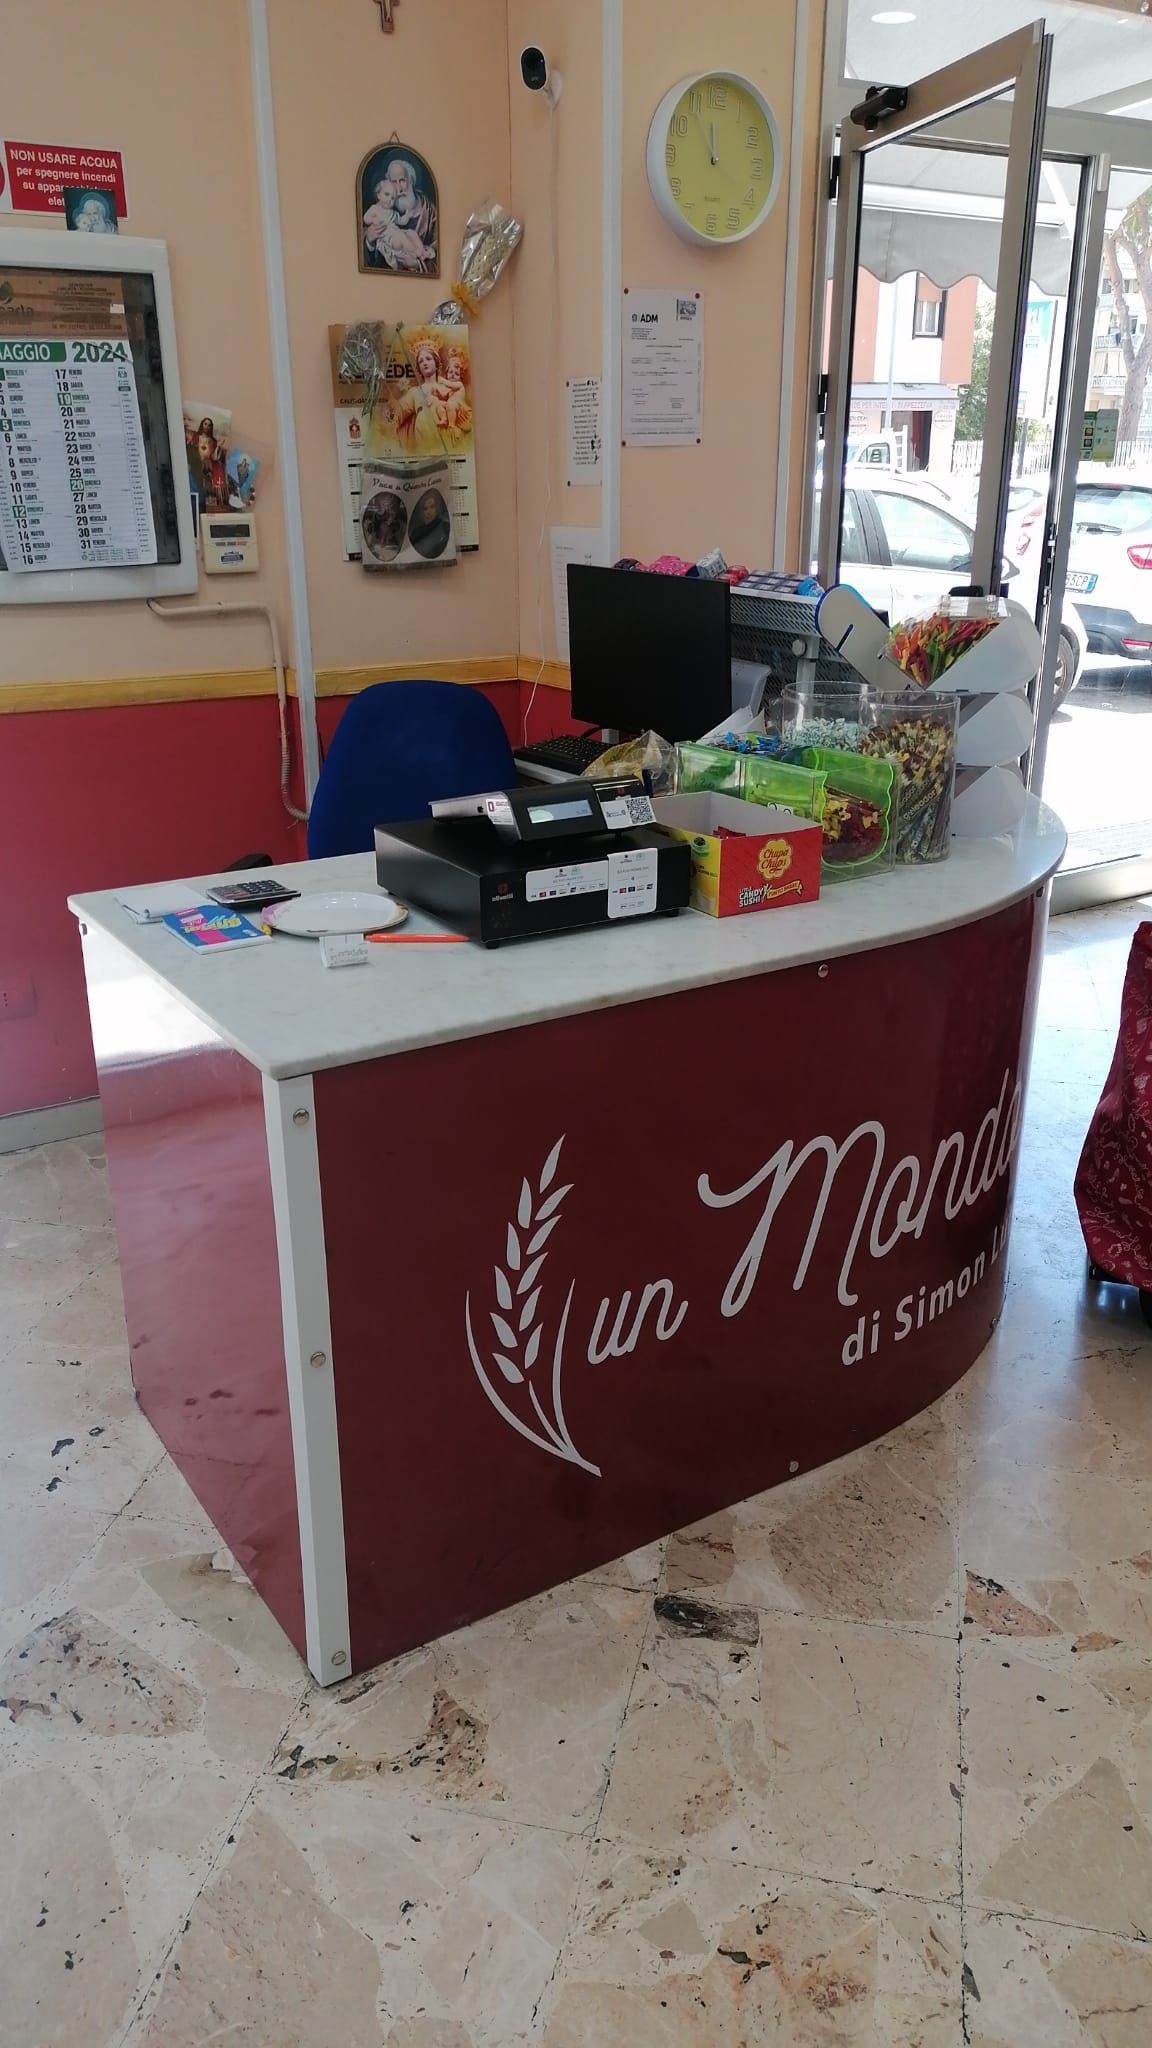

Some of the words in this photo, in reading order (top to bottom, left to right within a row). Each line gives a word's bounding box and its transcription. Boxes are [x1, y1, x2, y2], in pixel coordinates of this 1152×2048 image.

[709, 84, 727, 111] 12
[671, 114, 688, 137] 10
[745, 126, 759, 150] 2
[10, 149, 36, 162] NON
[38, 151, 77, 166] USARE
[80, 155, 118, 169] ACQUA
[751, 157, 763, 180] 3
[16, 167, 32, 177] per
[35, 168, 80, 180] spegnere
[81, 170, 116, 183] incendi
[23, 181, 35, 190] su
[741, 188, 755, 210] 4
[727, 207, 742, 230] 5
[640, 313, 659, 323] ADM
[71, 341, 128, 363] 2024
[55, 368, 66, 380] 17
[57, 381, 69, 392] 18
[59, 394, 71, 405] 19
[1, 407, 7, 418] 4
[60, 406, 73, 417] 20
[2, 420, 10, 431] 5
[63, 418, 74, 430] 21
[4, 432, 11, 443] 6
[64, 431, 77, 442] 22
[6, 445, 12, 456] 7
[66, 443, 79, 454] 23
[8, 457, 15, 468] 8
[67, 455, 80, 466] 24
[10, 470, 17, 480] 9
[70, 467, 82, 478] 25
[10, 482, 22, 492] 10
[71, 480, 83, 491] 26
[12, 494, 23, 505] 11
[72, 492, 84, 502] 27
[13, 507, 26, 518] 12
[74, 503, 87, 514] 28
[16, 518, 28, 529] 13
[76, 515, 88, 526] 29
[18, 530, 30, 541] 14
[78, 527, 90, 538] 30
[20, 542, 32, 553] 15
[80, 539, 91, 549] 31
[22, 554, 34, 565] 16
[903, 788, 938, 821] goleador
[763, 848, 789, 861] Chupa
[761, 858, 787, 870] Chups
[739, 887, 764, 900] CANDY
[739, 895, 761, 908] SUSHI
[841, 1310, 881, 1366] di
[894, 1251, 986, 1342] Simon
[587, 1278, 689, 1365] un
